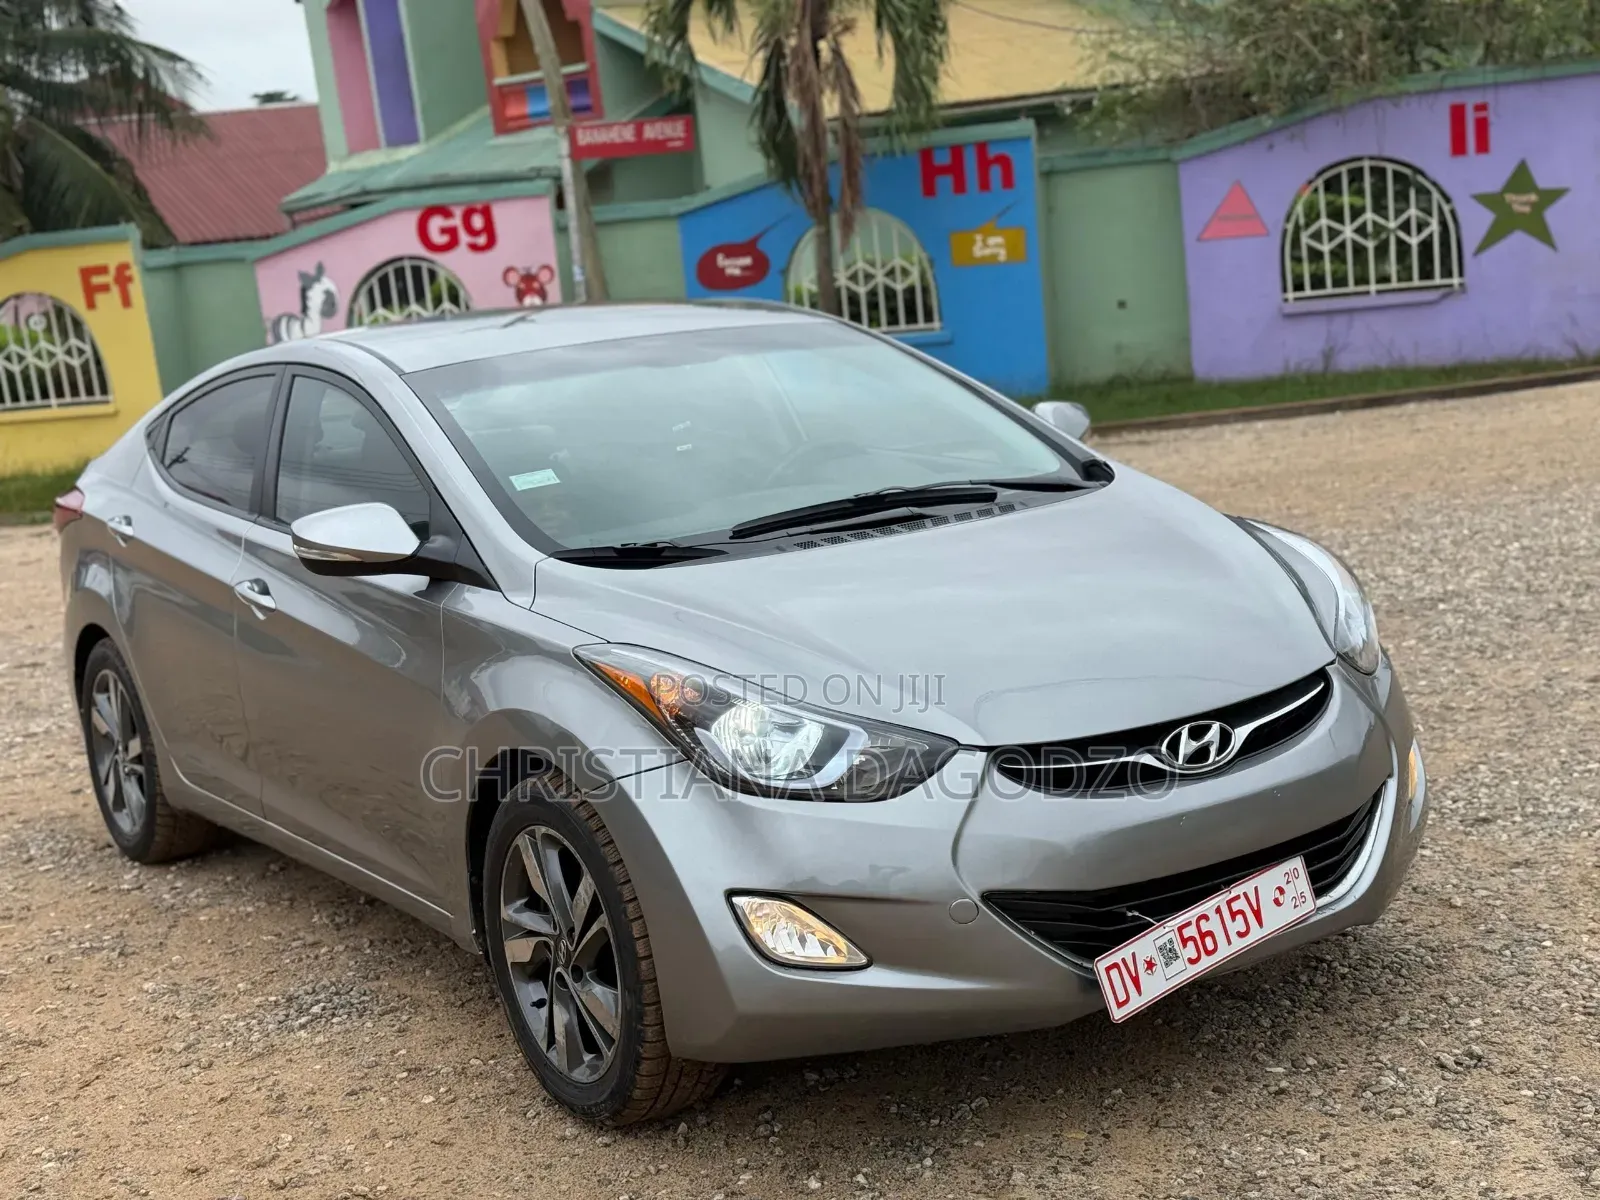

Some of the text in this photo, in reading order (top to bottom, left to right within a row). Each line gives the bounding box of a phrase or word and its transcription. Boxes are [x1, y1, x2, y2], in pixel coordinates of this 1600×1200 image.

[642, 119, 687, 141] AVENUE
[919, 140, 1015, 198] Hh
[417, 202, 497, 254] Gg
[78, 262, 134, 312] Ff
[1104, 885, 1264, 1010] DV 5615V
